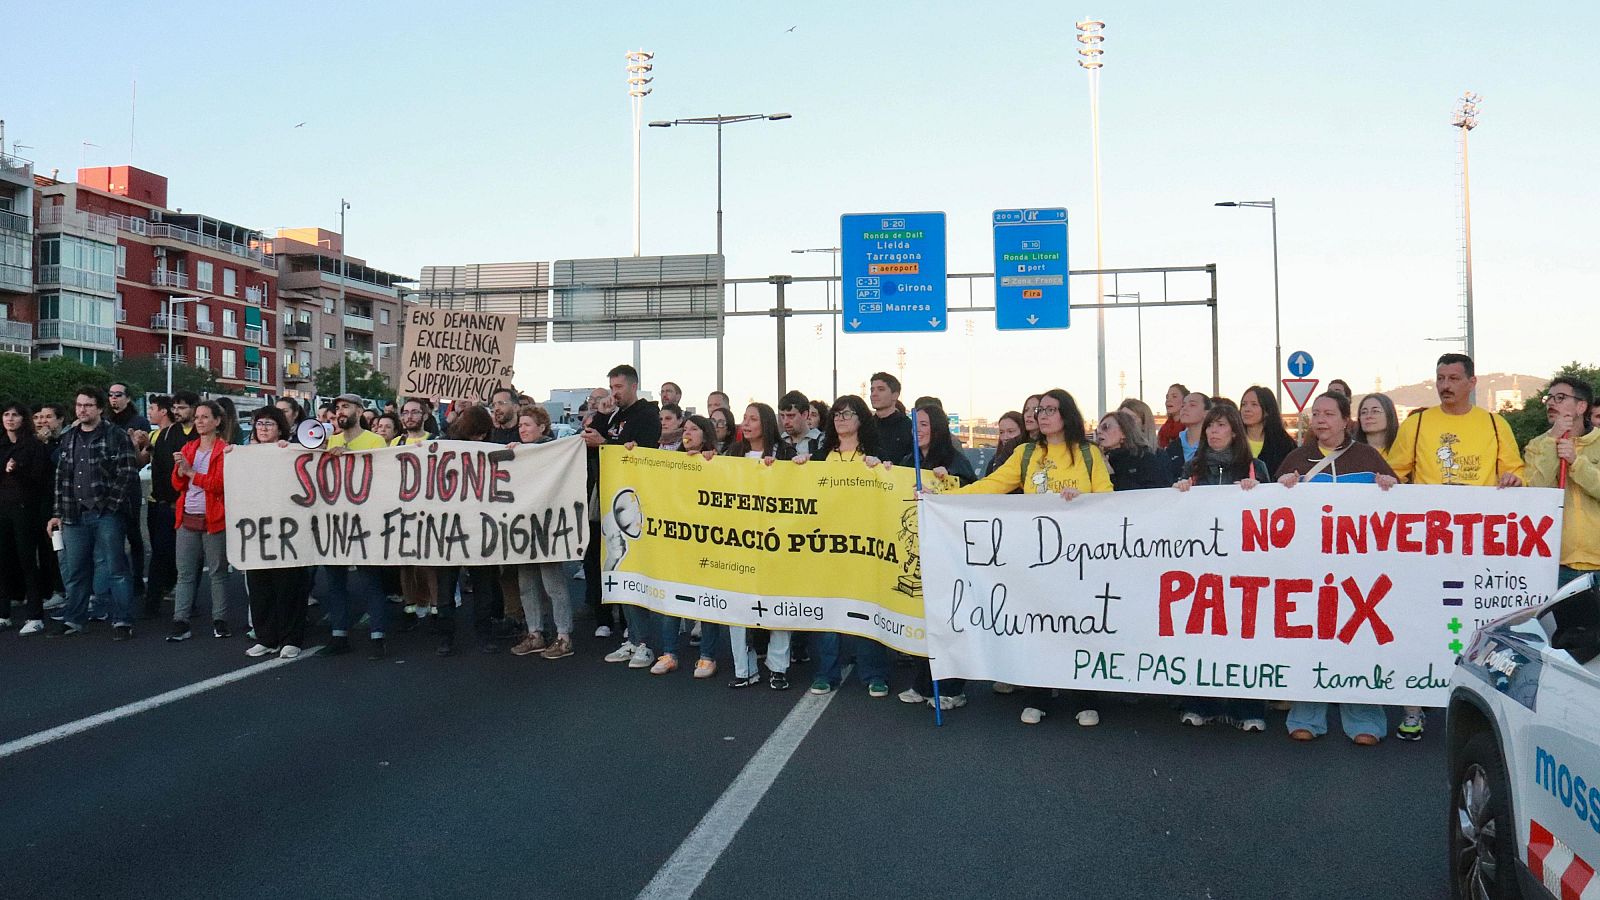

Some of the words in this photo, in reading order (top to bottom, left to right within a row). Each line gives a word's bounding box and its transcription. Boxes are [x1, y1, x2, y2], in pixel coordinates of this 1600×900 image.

[882, 220, 904, 228] B-20
[877, 241, 910, 249] Lleida
[866, 252, 922, 262] Tarragona
[1032, 252, 1059, 260] Litoral
[880, 264, 917, 273] aeroport
[1027, 263, 1046, 272] port
[858, 278, 879, 286] C-33
[897, 283, 933, 292] Girona
[858, 290, 879, 298] AP-7
[1023, 289, 1041, 298] Fira
[885, 303, 931, 312] Manresa
[412, 310, 435, 327] ENS
[443, 312, 506, 333] DEMANEN
[409, 350, 432, 370] AMB
[436, 352, 502, 376] PRESSUPOST
[500, 364, 513, 377] DE
[290, 451, 374, 507] SOU
[697, 489, 818, 515] DEFENSEM
[235, 515, 299, 562] PER
[310, 511, 371, 560] UNA
[646, 516, 781, 552] L'EDUCACIÓ
[787, 527, 900, 564] PÚBLICA
[963, 517, 1007, 567] El
[1028, 515, 1229, 580] Departament
[1241, 506, 1296, 552] NO
[698, 555, 757, 575] #salaridigne
[622, 577, 667, 600] recursos
[697, 592, 728, 611] ràtio
[946, 578, 1122, 637] l'alumnat
[773, 602, 825, 621] diàleg
[1196, 657, 1292, 689] LLEURE
[1312, 661, 1396, 691] també
